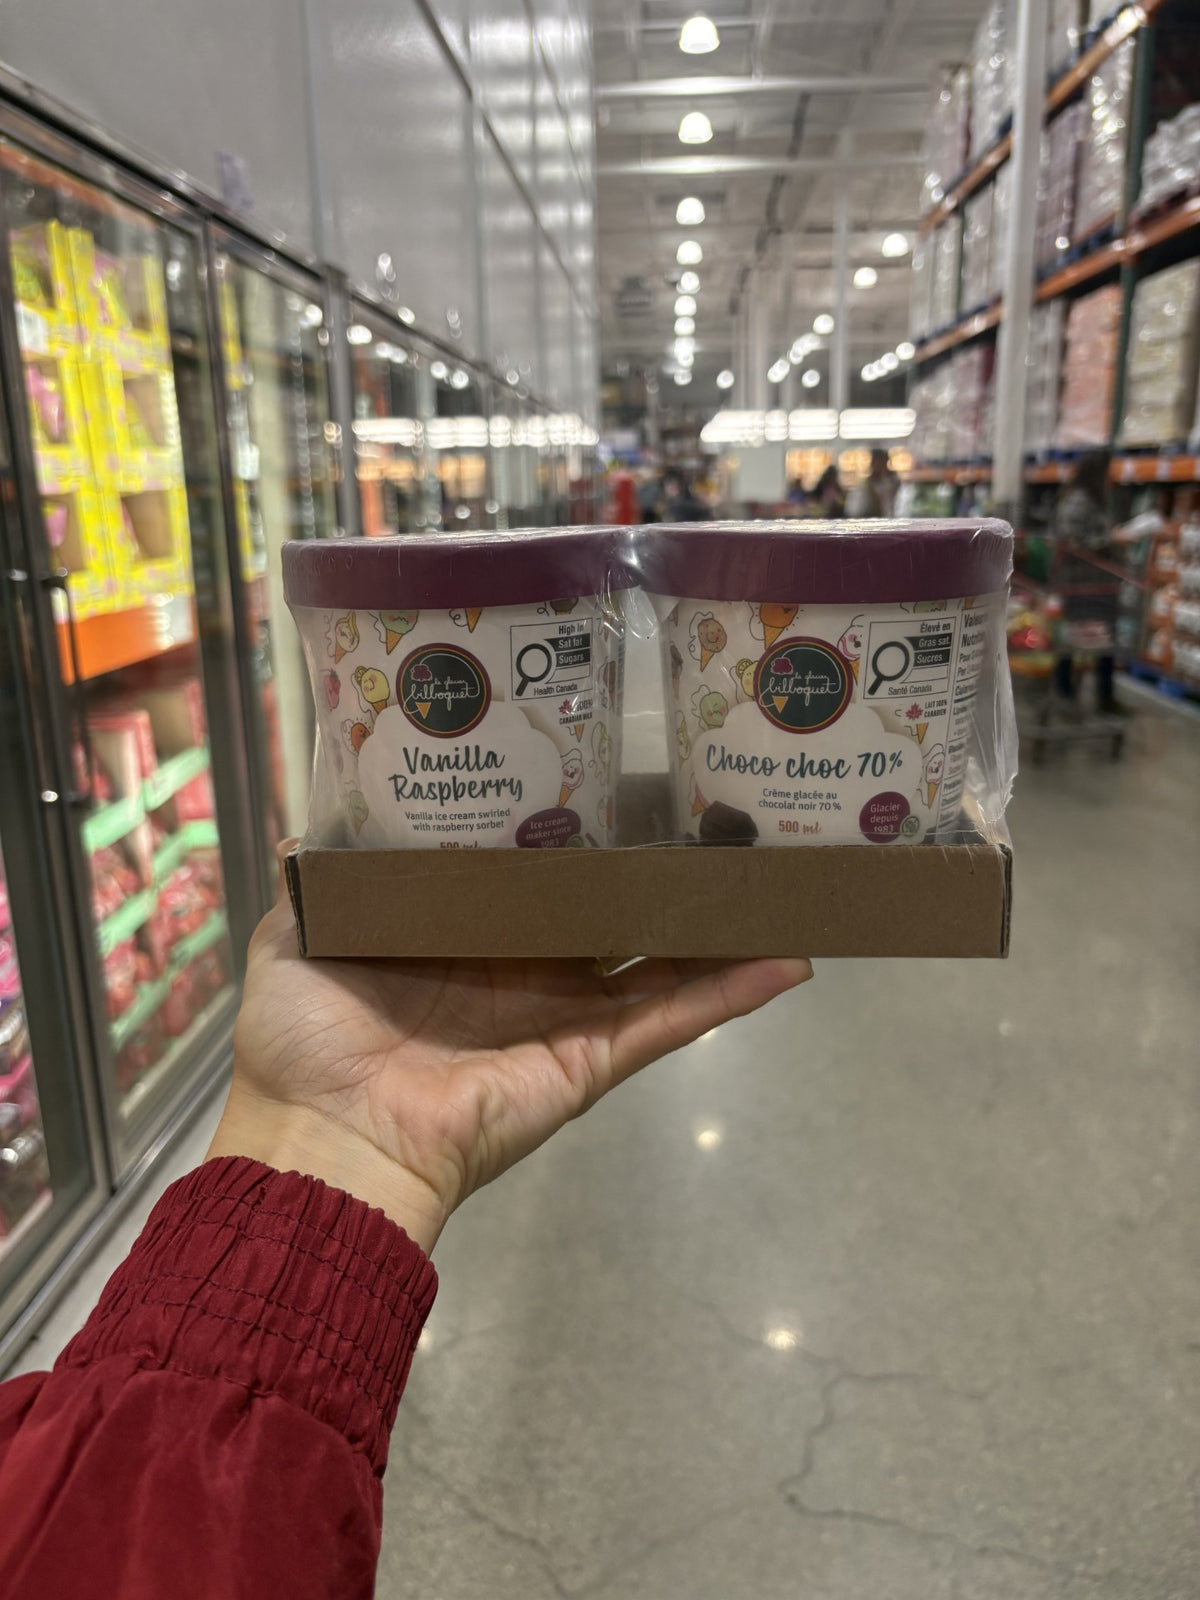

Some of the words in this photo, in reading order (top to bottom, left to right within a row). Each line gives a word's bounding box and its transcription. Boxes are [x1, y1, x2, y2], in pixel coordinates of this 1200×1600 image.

[558, 625, 576, 635] High
[920, 622, 940, 633] Élevé
[942, 623, 951, 631] en
[558, 640, 571, 649] Sat
[573, 637, 583, 646] fat
[918, 638, 936, 648] Gras
[558, 653, 584, 665] Sugars
[916, 654, 943, 664] Sucres
[533, 686, 555, 697] Health
[556, 682, 578, 694] Canada
[769, 676, 837, 707] bilboquet
[887, 685, 908, 697] Santé
[909, 684, 932, 695] Canada
[410, 683, 475, 712] bilboquet
[402, 744, 506, 775] Vanilla
[706, 744, 781, 777] Choco
[786, 752, 851, 779] choc
[857, 750, 903, 778] 70%
[388, 774, 523, 807] Raspberry
[762, 788, 792, 799] Crème
[793, 790, 824, 801] glacée
[825, 792, 838, 800] au
[758, 799, 796, 811] chocolat
[798, 801, 817, 811] noir
[870, 802, 901, 813] Glacier
[405, 811, 433, 821] Vanilla
[435, 811, 448, 821] ice
[449, 811, 476, 820] cream
[478, 808, 511, 819] swirled
[870, 812, 899, 825] depuis
[412, 822, 431, 832] with
[433, 823, 475, 833] raspberry
[476, 820, 504, 830] sorbet
[530, 821, 544, 830] Ice
[544, 816, 569, 828] cream
[778, 820, 800, 833] 500
[802, 821, 822, 835] ml
[874, 824, 894, 834] 1983
[525, 830, 551, 841] maker
